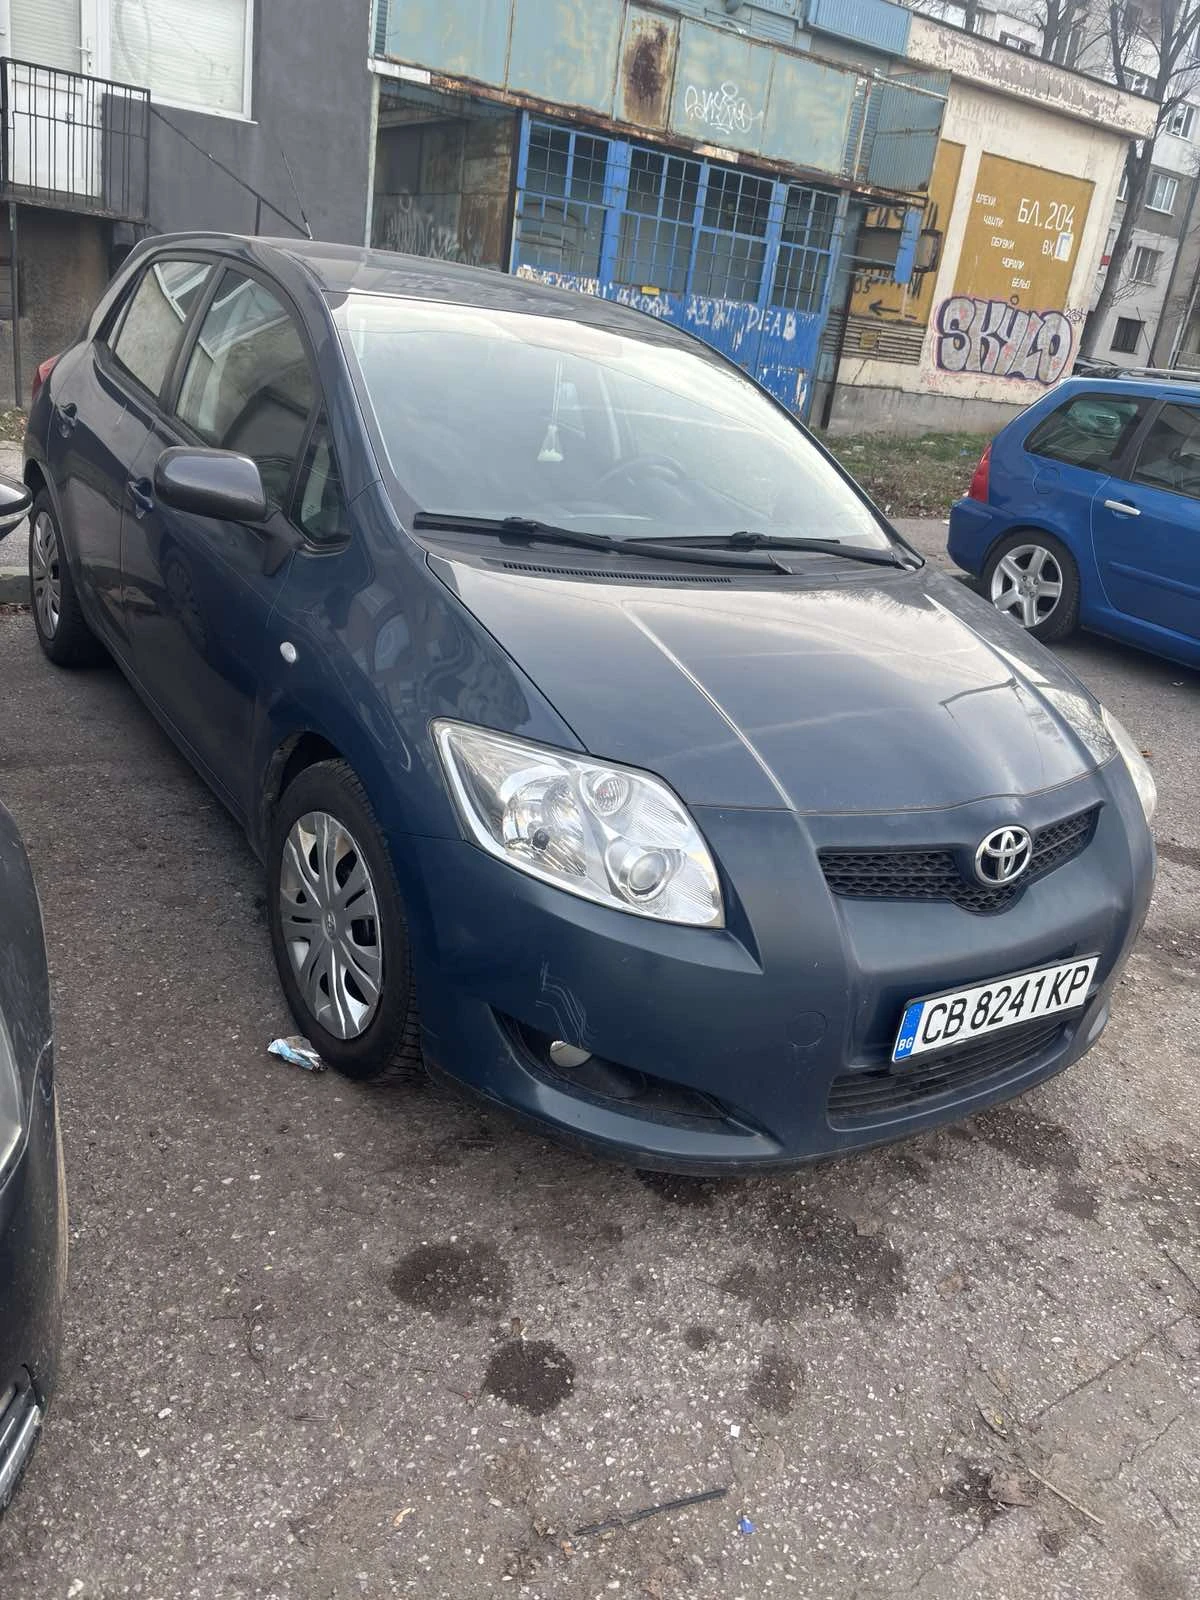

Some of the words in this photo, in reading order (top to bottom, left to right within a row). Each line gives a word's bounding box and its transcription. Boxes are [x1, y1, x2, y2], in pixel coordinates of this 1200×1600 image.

[1017, 198, 1075, 232] БЛ.204
[991, 236, 1015, 250] ОБУВКИ
[936, 296, 1073, 386] SKYLO
[922, 998, 968, 1044] CB
[970, 975, 1047, 1030] 8241
[1046, 964, 1090, 1009] KP
[898, 1037, 914, 1051] BG
